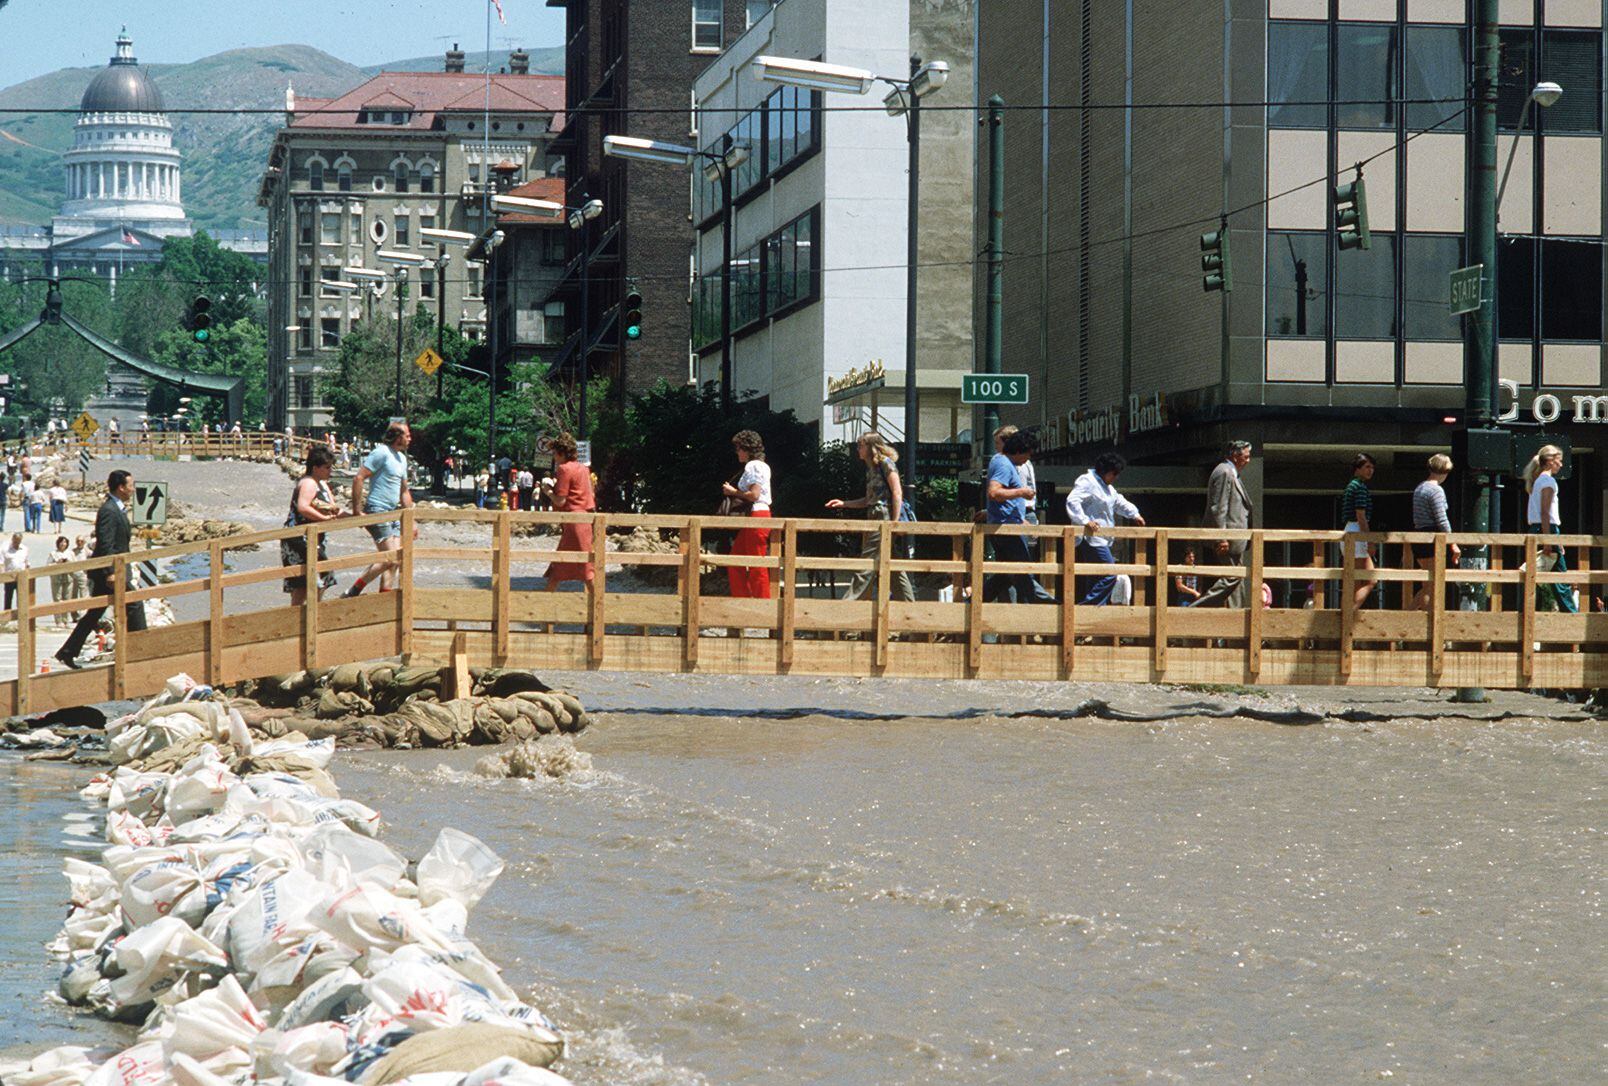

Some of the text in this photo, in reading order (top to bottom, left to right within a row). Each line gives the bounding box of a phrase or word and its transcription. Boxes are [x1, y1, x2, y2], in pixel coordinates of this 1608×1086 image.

[1453, 277, 1478, 303] STATE
[972, 381, 1018, 396] 100 S
[1067, 404, 1121, 446] Security
[1128, 391, 1163, 433] Bank
